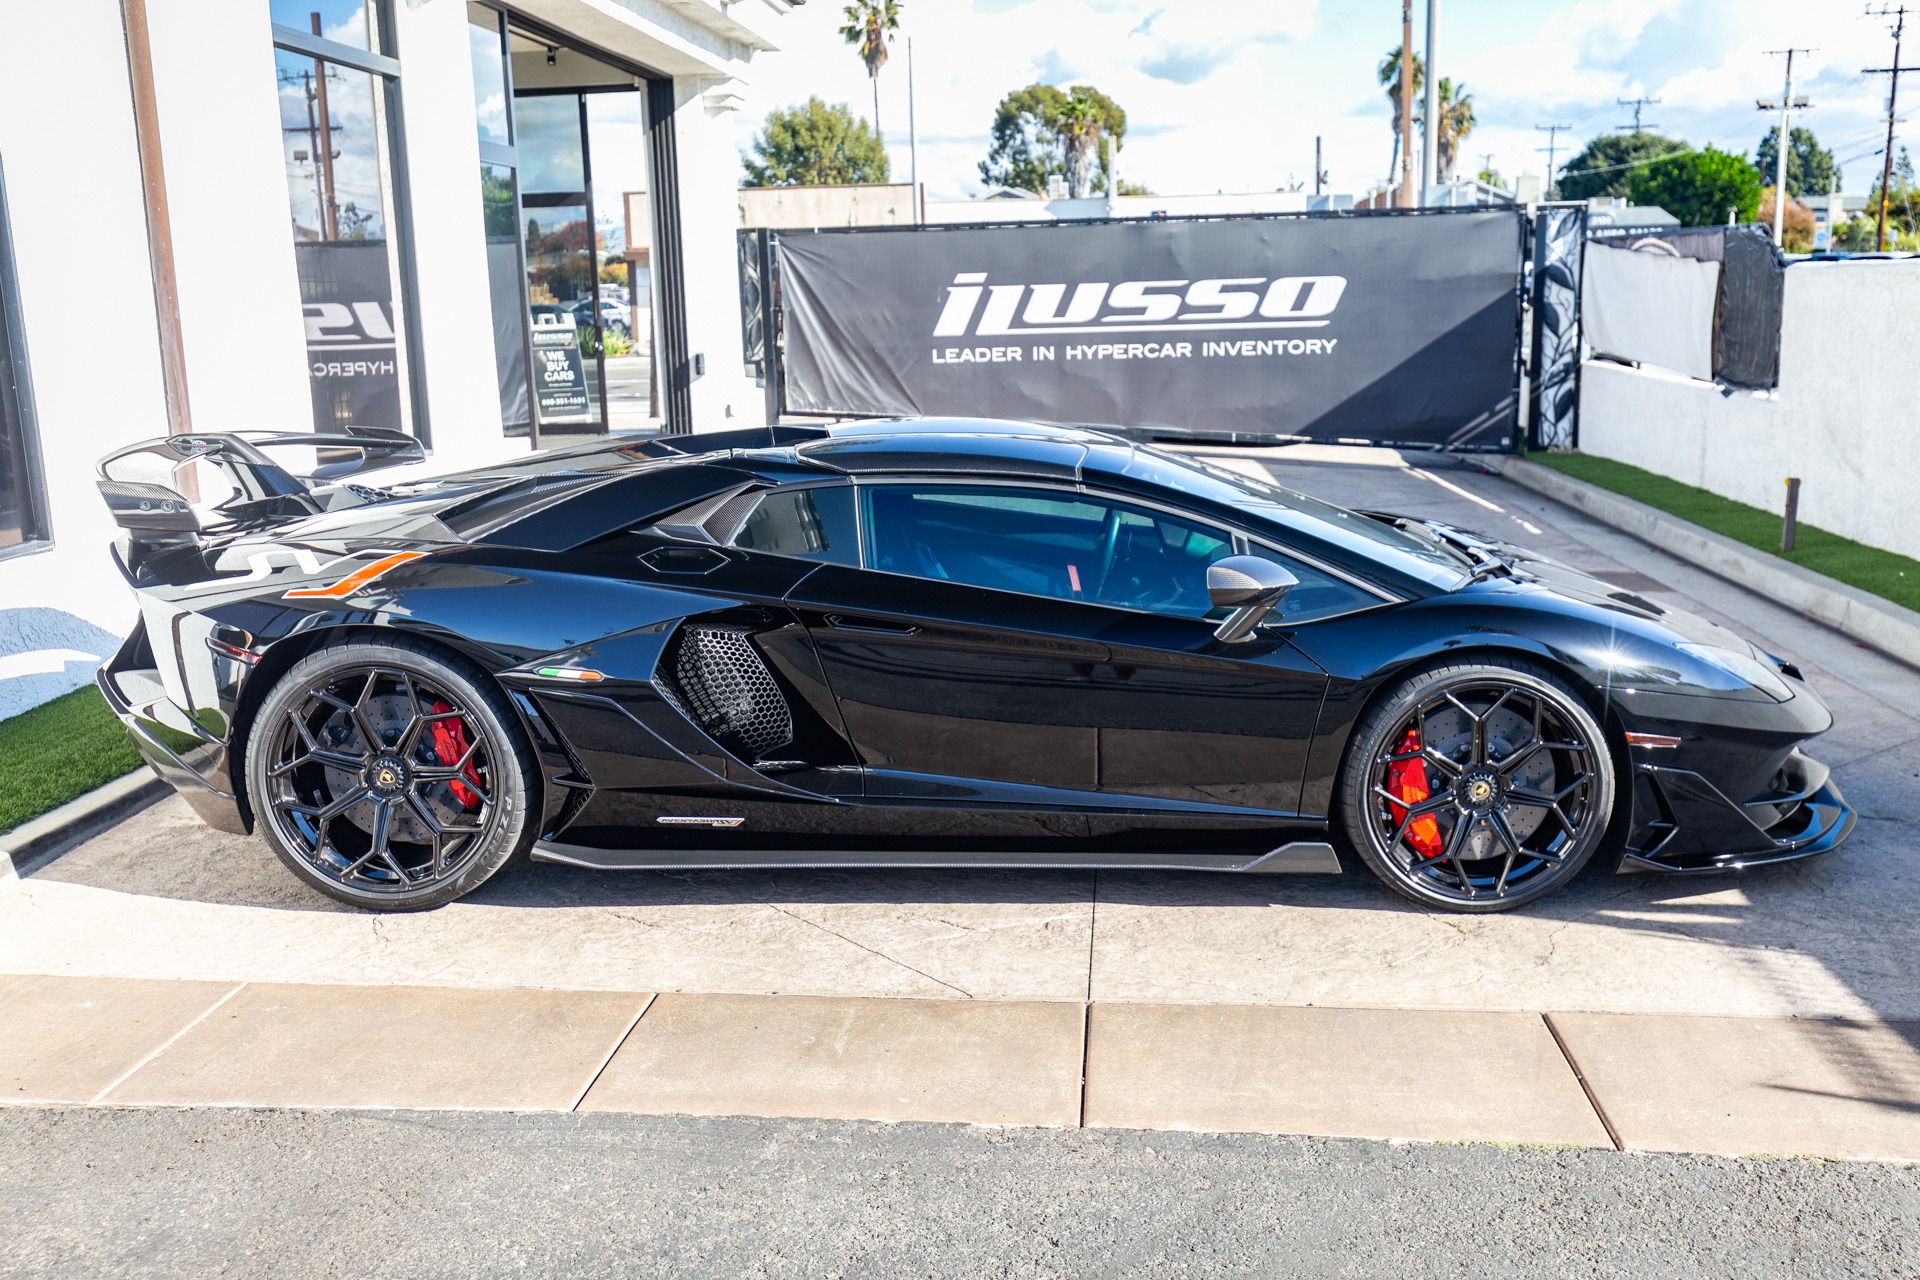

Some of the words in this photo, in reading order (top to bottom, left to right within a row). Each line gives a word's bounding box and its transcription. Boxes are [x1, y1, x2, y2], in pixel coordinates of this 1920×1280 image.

[546, 351, 566, 361] WE
[932, 346, 1022, 364] LEADER
[1033, 346, 1055, 361] IN
[1066, 342, 1192, 361] HYPERCAR
[1202, 338, 1338, 358] INVENTORY
[546, 361, 569, 371] BUY
[544, 370, 575, 382] CARS
